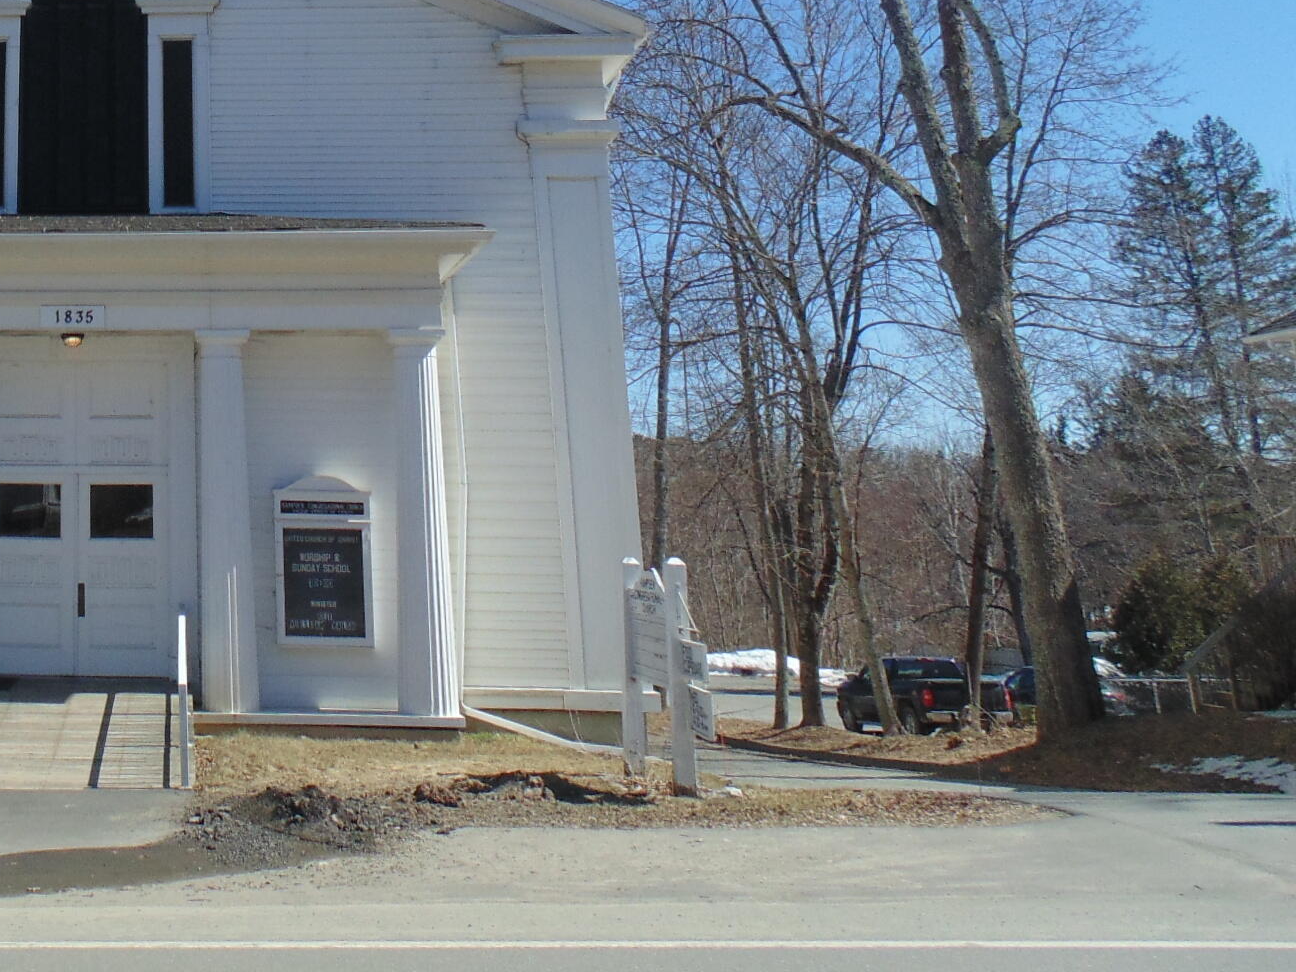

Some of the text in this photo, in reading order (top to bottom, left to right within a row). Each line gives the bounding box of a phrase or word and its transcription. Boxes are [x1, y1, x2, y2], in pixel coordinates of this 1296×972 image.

[55, 309, 94, 325] 1835
[299, 552, 331, 563] WORSHIP
[292, 563, 351, 573] SUNDAY SCHOOL
